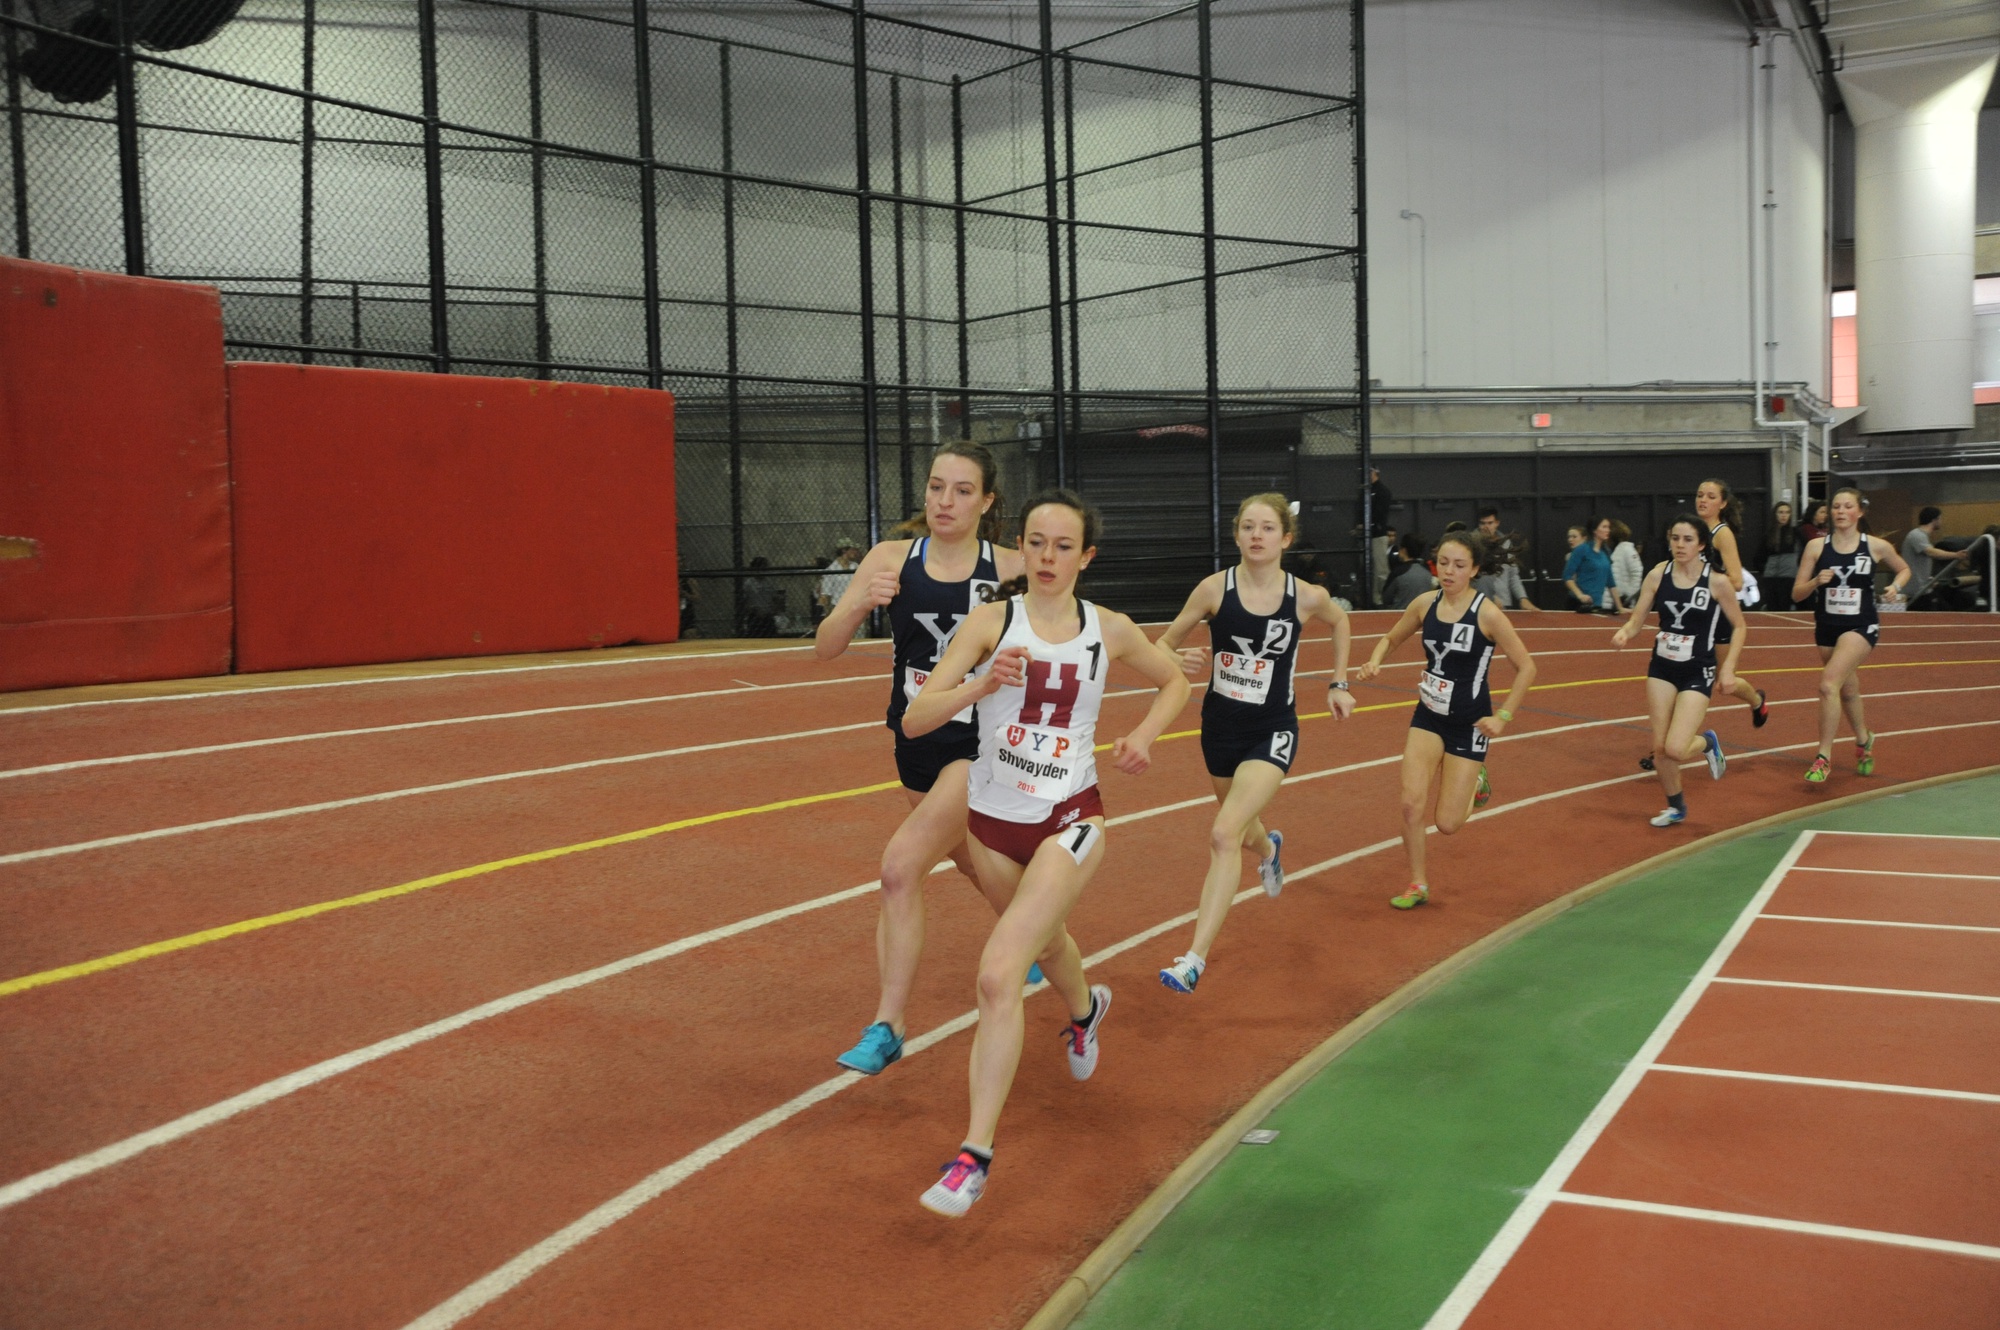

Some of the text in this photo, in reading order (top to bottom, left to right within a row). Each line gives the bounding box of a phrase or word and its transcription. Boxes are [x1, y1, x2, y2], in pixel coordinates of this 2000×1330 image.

[1829, 565, 1856, 588] Y
[1858, 558, 1867, 572] 7
[1694, 589, 1707, 607] 6
[1664, 601, 1692, 629] Y
[1266, 623, 1288, 652] 2
[1454, 626, 1469, 650] 4
[1086, 641, 1101, 681] 1
[1253, 660, 1266, 675] P
[1424, 639, 1453, 676] Y
[1220, 670, 1263, 690] Demaree
[1019, 660, 1080, 729] H
[1230, 690, 1244, 699] 2015
[1032, 732, 1048, 751] Y
[1052, 736, 1070, 758] P
[1275, 732, 1290, 760] 2
[1475, 733, 1486, 750] 4
[998, 747, 1068, 781] Shwayder
[1017, 781, 1036, 793] 2015
[1071, 824, 1092, 853] 1
